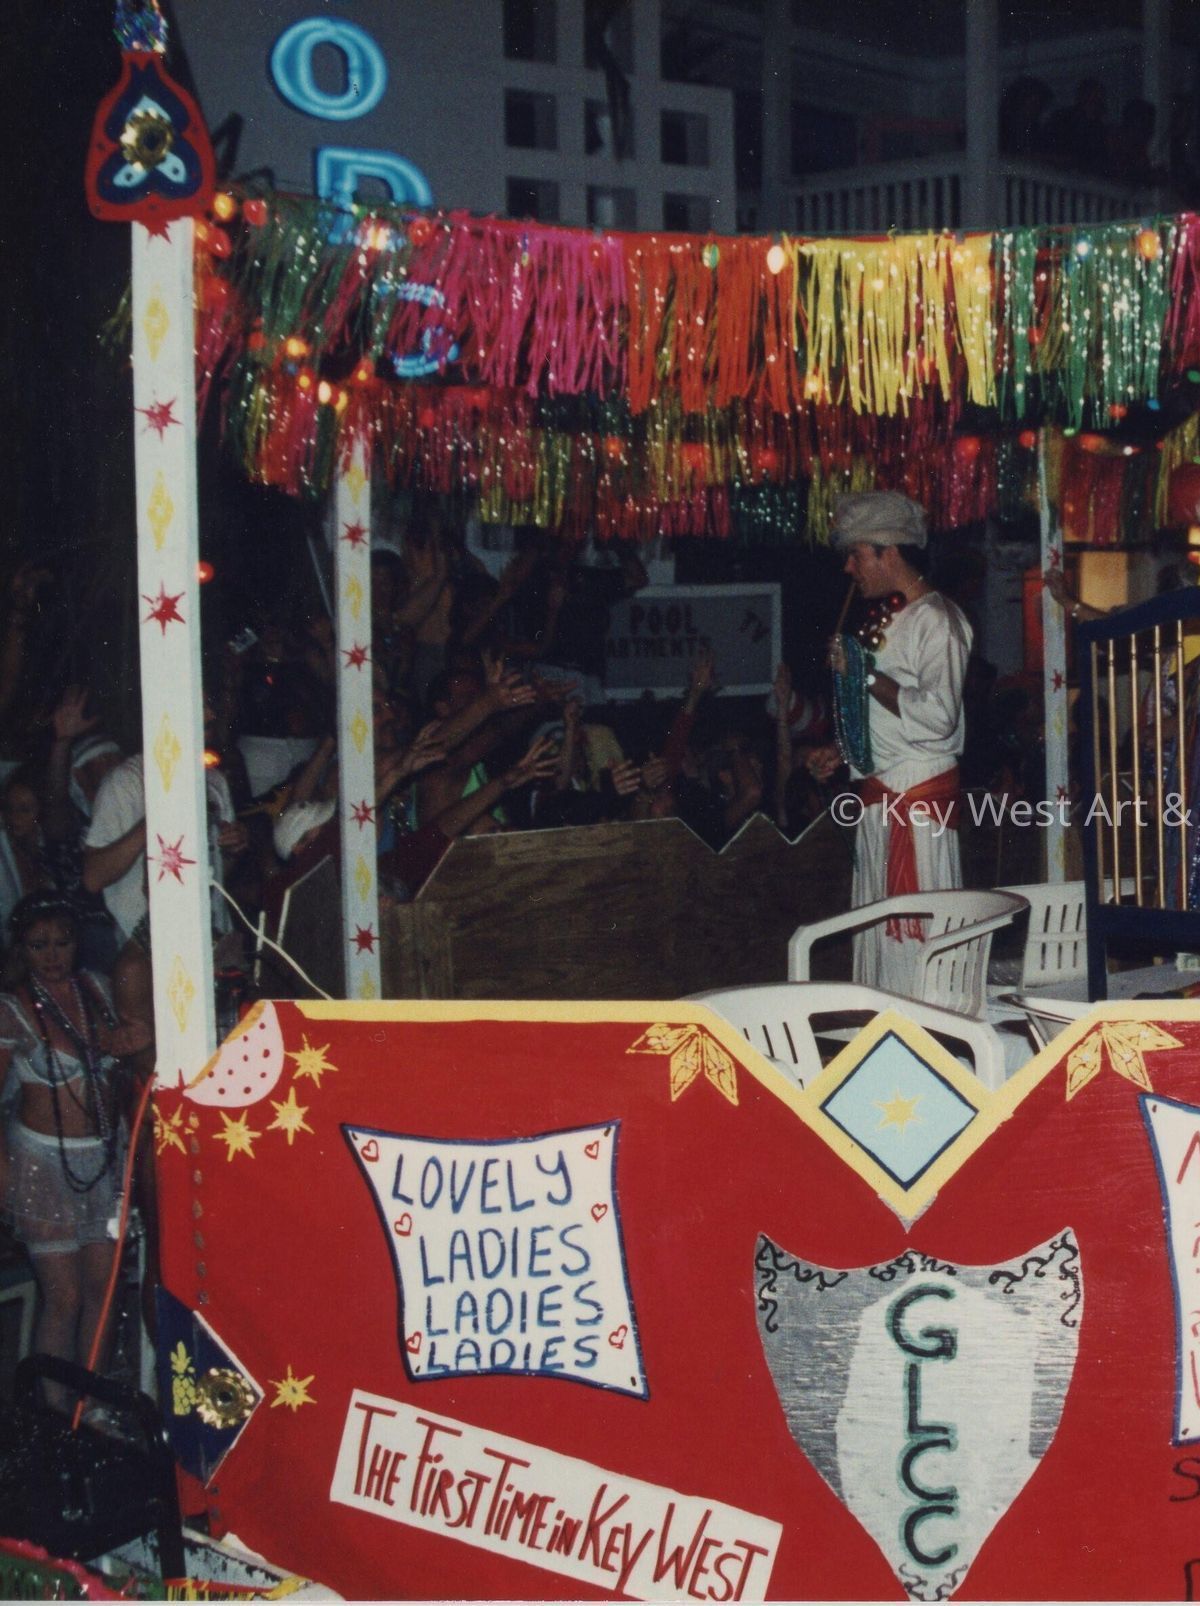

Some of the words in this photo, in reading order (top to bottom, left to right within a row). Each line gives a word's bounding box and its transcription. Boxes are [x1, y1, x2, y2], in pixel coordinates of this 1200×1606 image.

[630, 603, 699, 635] POOL
[391, 1150, 574, 1215] LOVELY
[418, 1223, 591, 1286] LADIES
[424, 1279, 605, 1337] LADIES
[426, 1334, 600, 1372] LADIES
[885, 1281, 959, 1571] GLCC
[353, 1401, 408, 1507] THE
[577, 1483, 656, 1592] KEY
[652, 1502, 770, 1601] WEST
